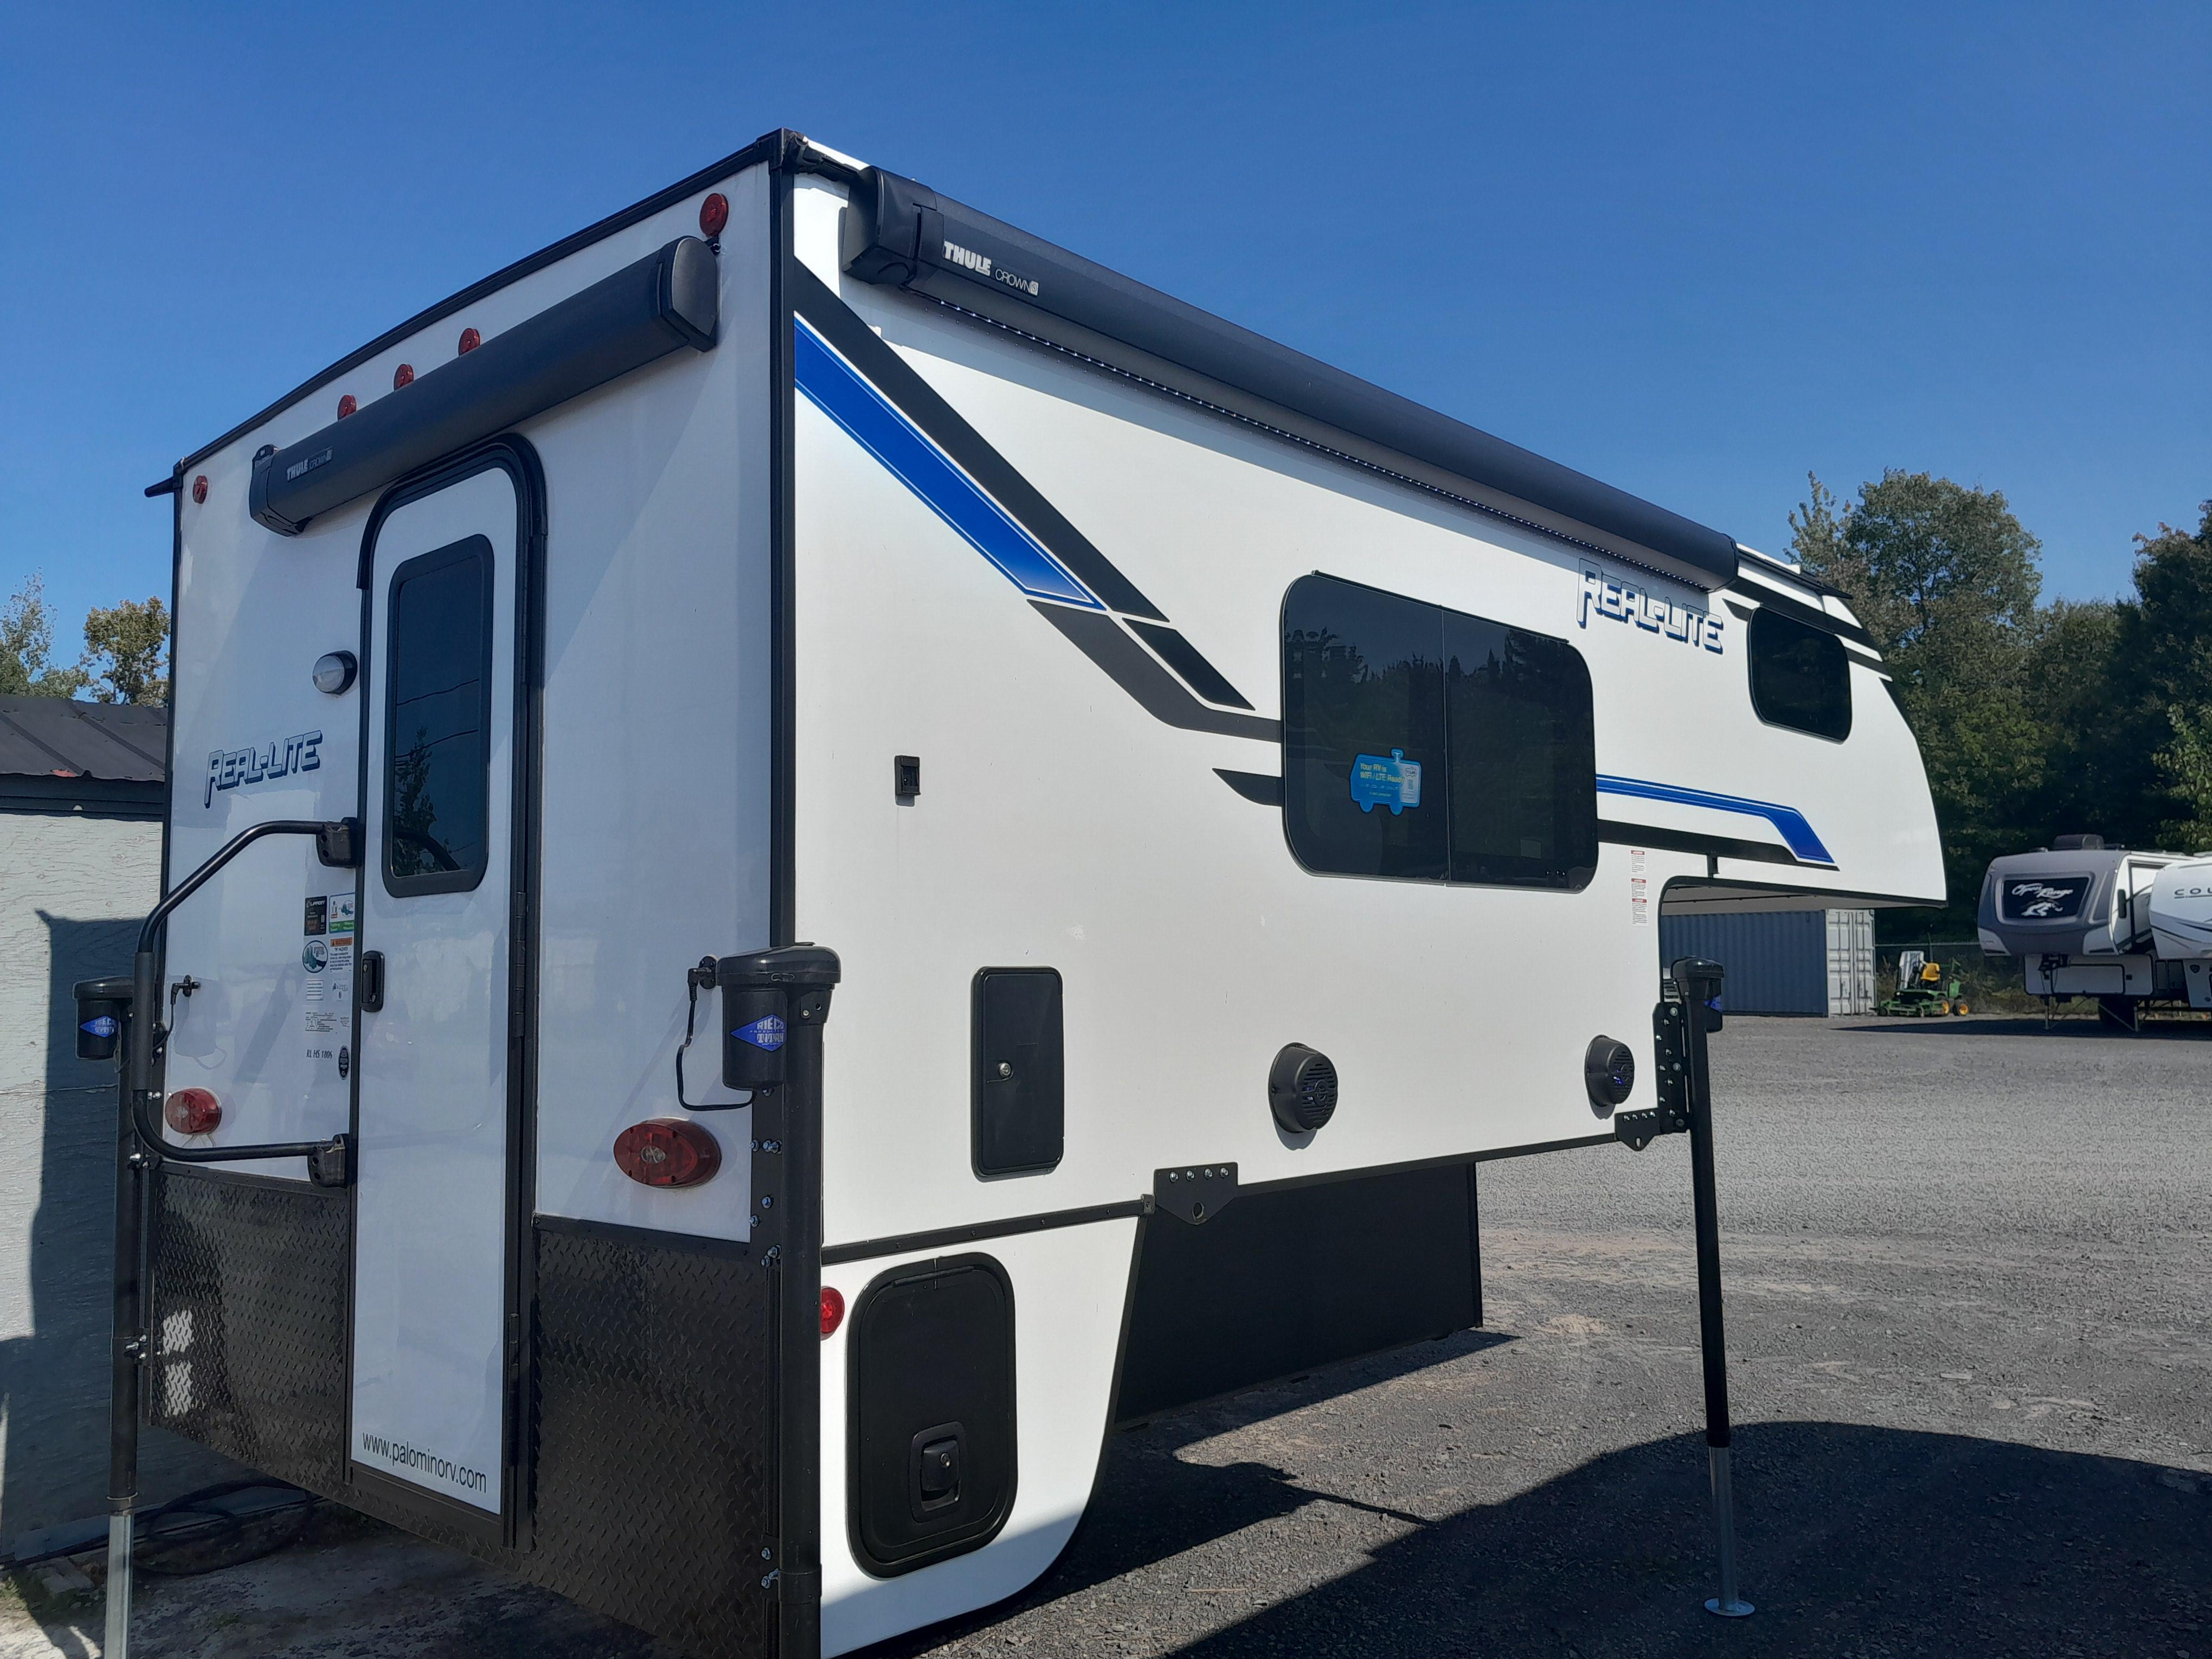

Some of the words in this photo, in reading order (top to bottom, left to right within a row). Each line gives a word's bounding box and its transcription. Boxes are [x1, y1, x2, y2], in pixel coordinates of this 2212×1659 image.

[943, 240, 992, 276] THULE
[995, 268, 1031, 293] CROWN
[286, 458, 308, 481] THULE
[1576, 557, 1724, 654] REAL-LITE
[204, 730, 323, 809] REAL-LITE
[1373, 763, 1381, 771] RV
[1375, 773, 1386, 781] LTE
[757, 1017, 784, 1030] RIECO
[362, 1432, 487, 1493] www.palominorv.com
